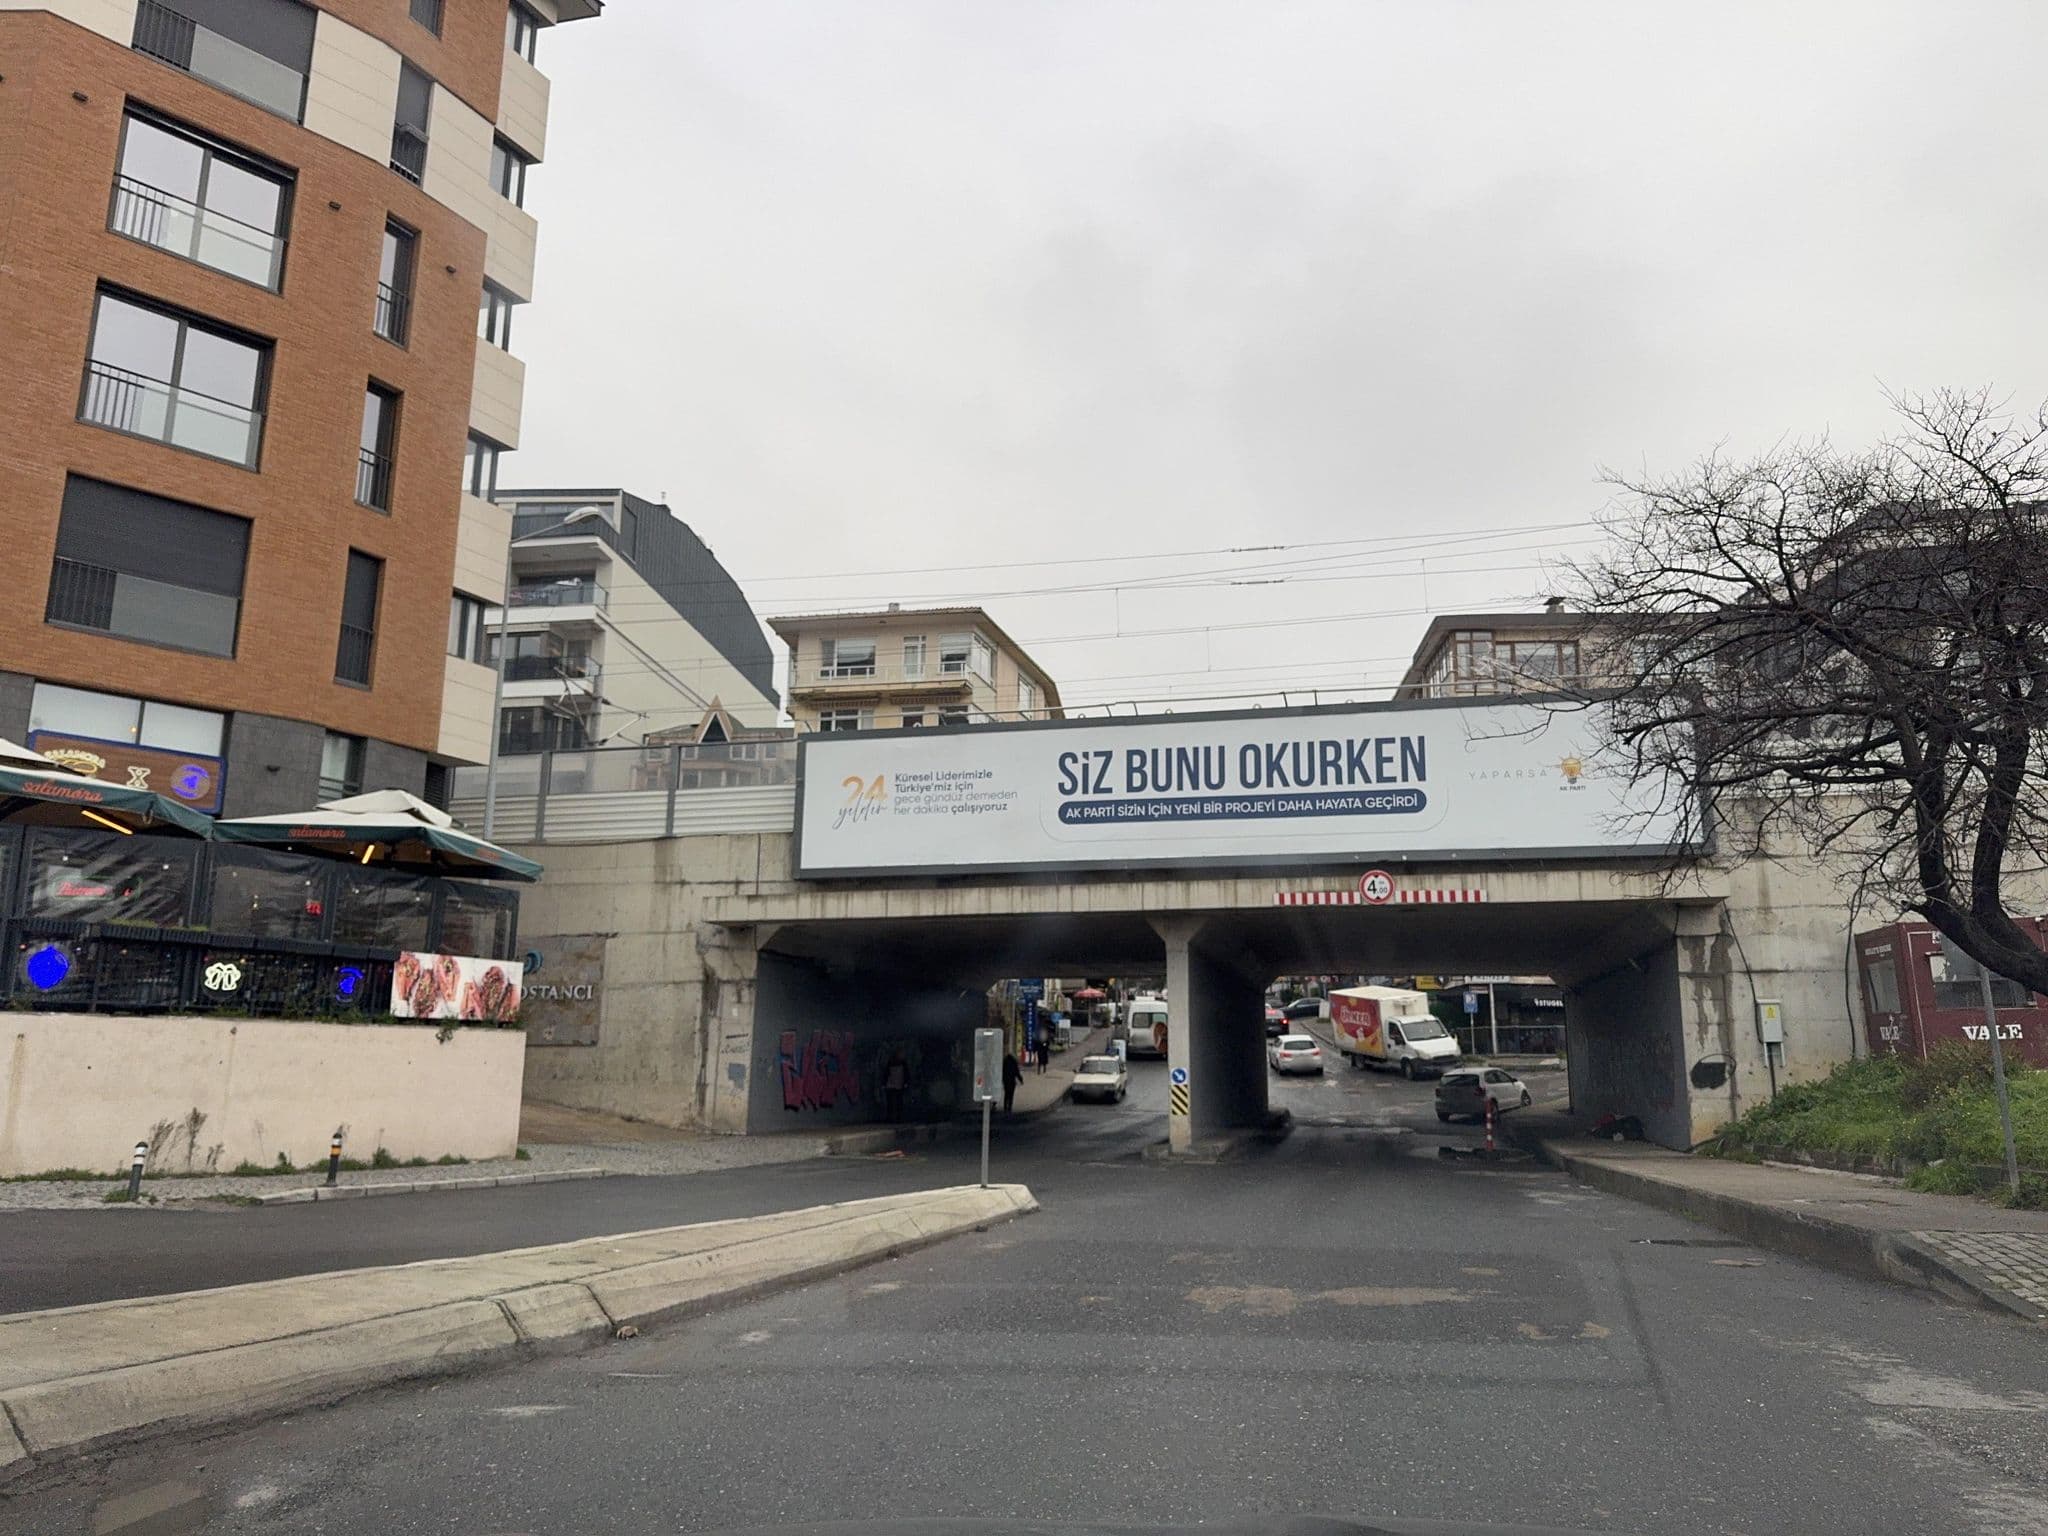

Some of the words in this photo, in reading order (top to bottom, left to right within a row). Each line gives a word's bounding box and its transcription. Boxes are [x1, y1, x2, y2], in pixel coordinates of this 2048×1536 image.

[1126, 745, 1226, 793] BUNU
[1239, 735, 1427, 789] OKURKEN
[895, 772, 933, 783] Küresel
[936, 769, 993, 781] Liderimizle
[1468, 769, 1547, 780] YAPARSA
[841, 773, 888, 803] 24
[894, 782, 952, 795] Türkiye'miz
[954, 781, 974, 793] için
[894, 795, 920, 805] gece
[924, 791, 963, 804] gündüz
[965, 790, 1018, 801] demeden
[894, 805, 910, 815] her
[913, 804, 949, 814] dakika
[950, 803, 1008, 815] çalışıyoruz
[1065, 807, 1081, 819] AK
[1084, 804, 1115, 818] PARTİ
[1117, 803, 1145, 817] SİZİN
[1148, 802, 1172, 818] İÇİN
[1174, 801, 1200, 815] YENİ
[1203, 800, 1222, 814] BİR
[1225, 799, 1275, 814] PROJEYİ
[1278, 798, 1312, 812] DAHA
[1316, 797, 1363, 811] HAYATA
[1364, 793, 1418, 810] GEÇİRDİ
[1962, 1023, 2023, 1040] VALE
